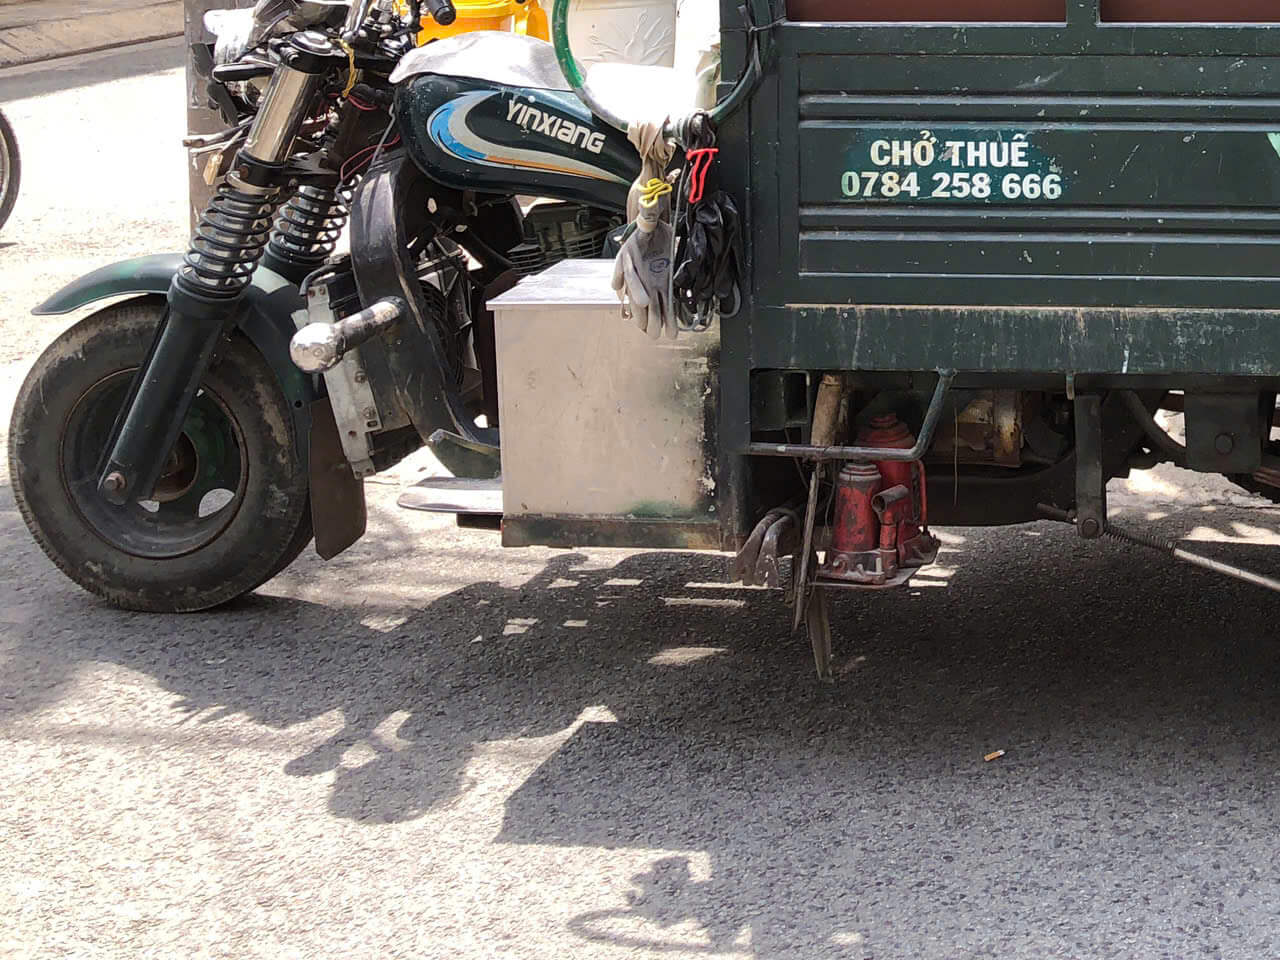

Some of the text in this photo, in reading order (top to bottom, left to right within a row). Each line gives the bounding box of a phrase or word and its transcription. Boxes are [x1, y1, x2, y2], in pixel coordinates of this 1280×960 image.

[870, 130, 1029, 168] CHỞ THUÊ
[841, 171, 1062, 200] 0784 258 666
